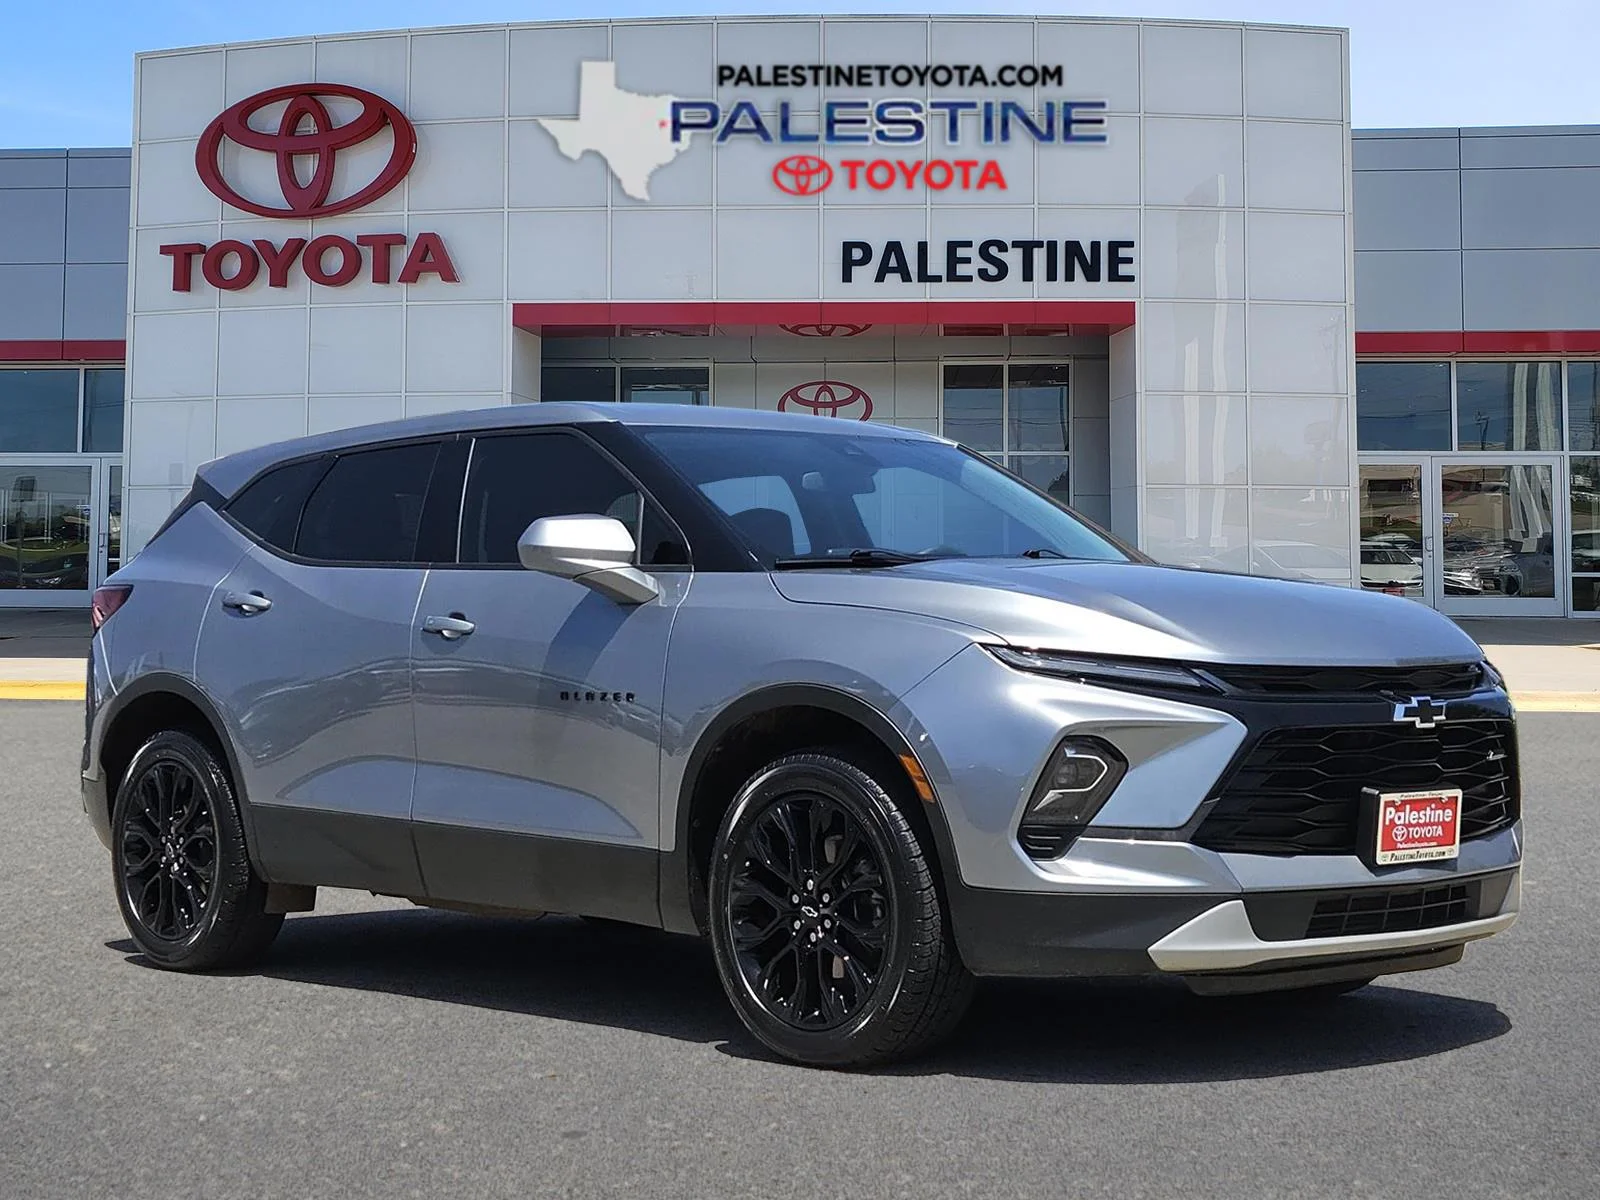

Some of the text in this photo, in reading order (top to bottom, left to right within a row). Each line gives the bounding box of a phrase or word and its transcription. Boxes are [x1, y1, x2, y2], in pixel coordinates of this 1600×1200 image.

[159, 232, 460, 292] TOYOTA
[841, 239, 1135, 283] PALESTINE
[560, 691, 635, 703] BLAZER
[1385, 803, 1453, 825] Palestine
[1408, 826, 1443, 839] TOYOTA
